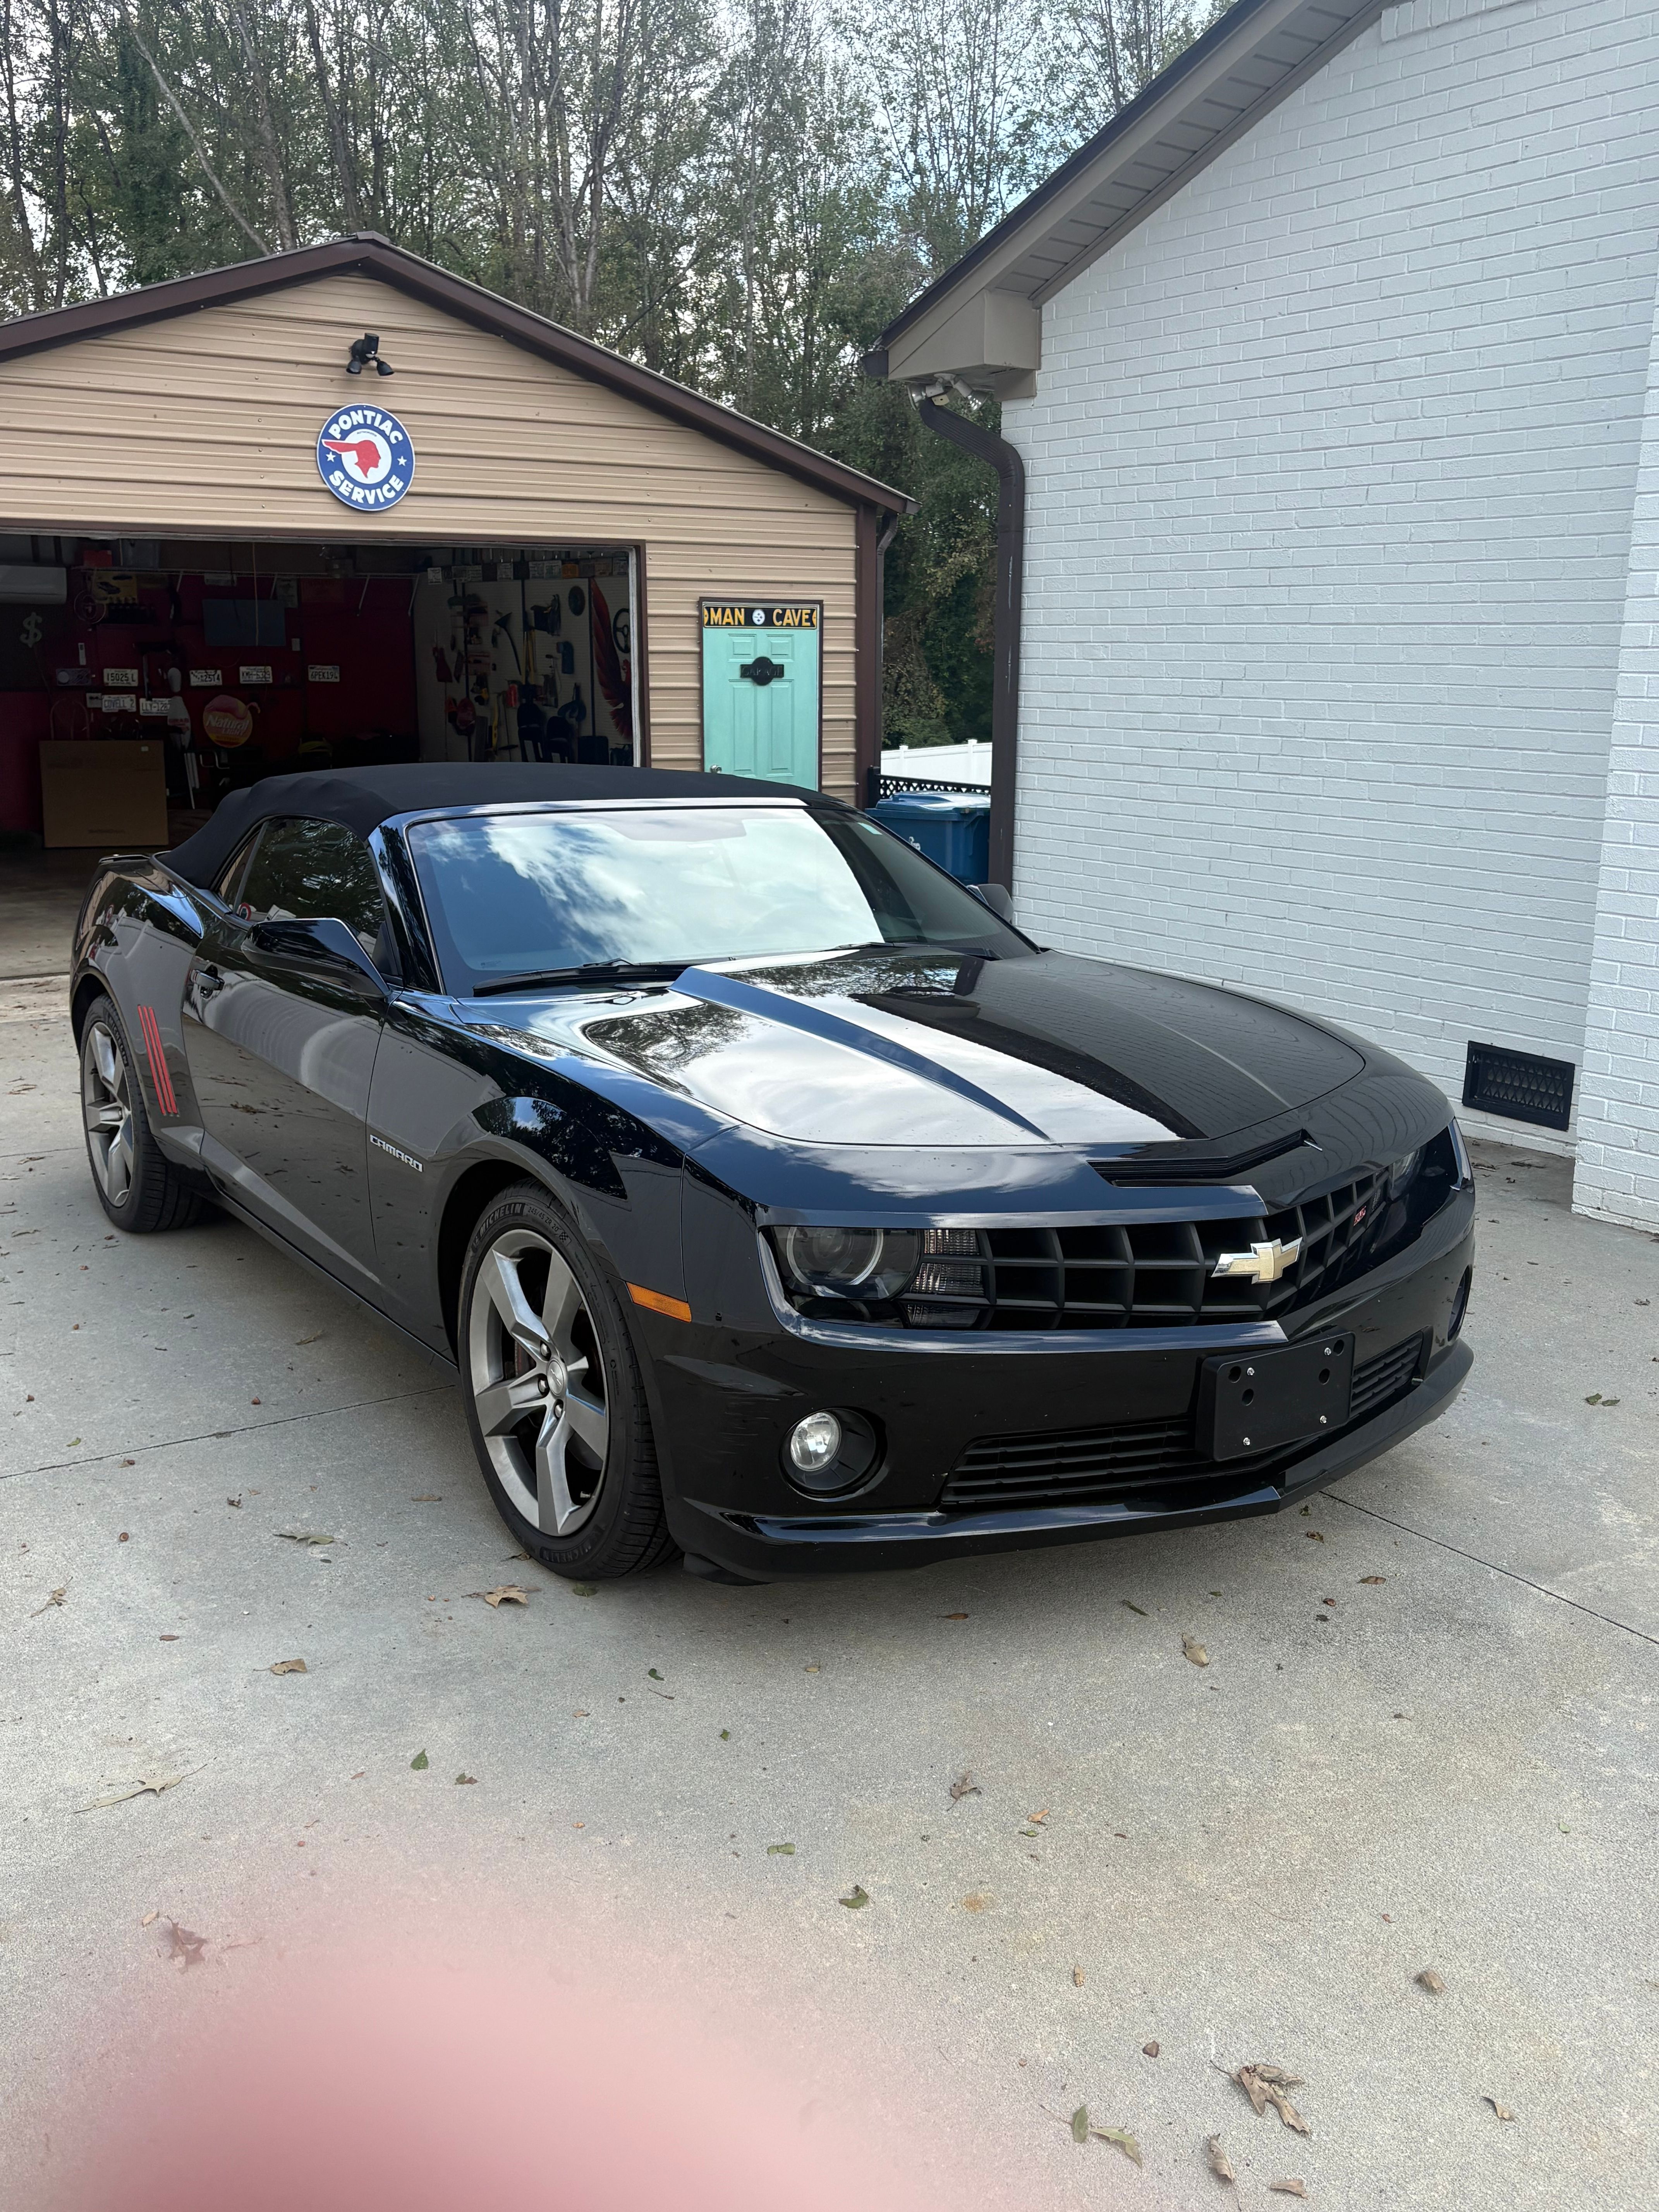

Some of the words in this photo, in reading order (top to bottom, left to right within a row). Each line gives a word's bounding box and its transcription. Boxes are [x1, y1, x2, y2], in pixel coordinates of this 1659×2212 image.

[328, 410, 403, 444] PONTIAC
[329, 470, 404, 504] SERVICE
[710, 608, 744, 625] MAN
[773, 609, 811, 626] CAVE
[206, 714, 249, 730] Natural
[370, 1134, 423, 1172] CAMARO
[479, 1203, 522, 1237] MICHELIN
[528, 1207, 546, 1220] 245/45
[545, 1217, 552, 1225] ZR
[551, 1224, 559, 1232] 20
